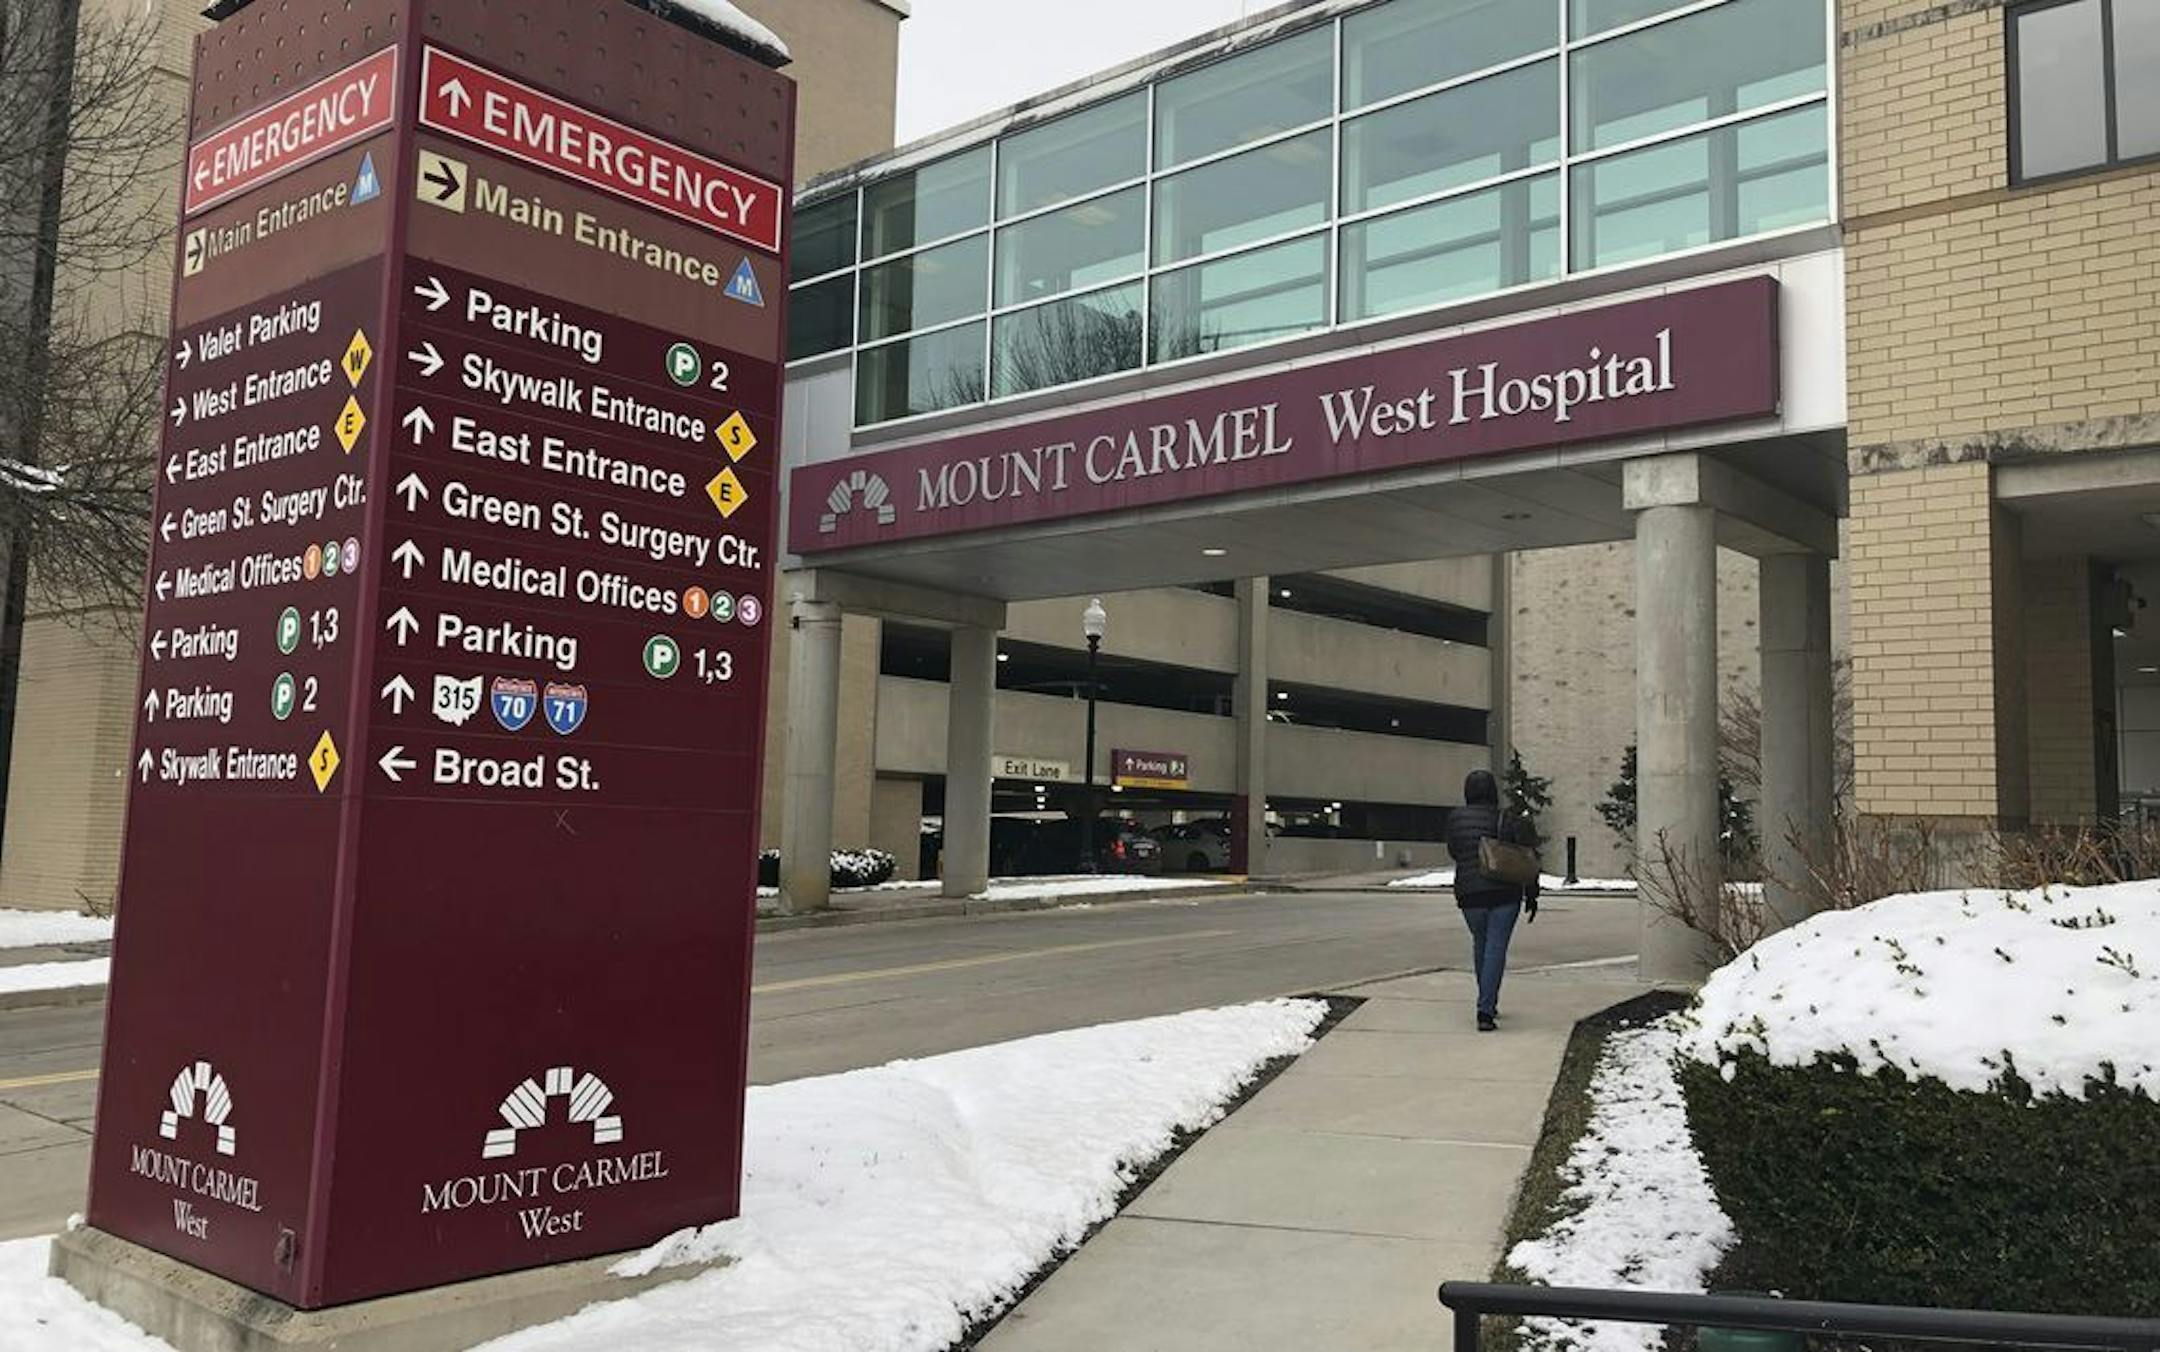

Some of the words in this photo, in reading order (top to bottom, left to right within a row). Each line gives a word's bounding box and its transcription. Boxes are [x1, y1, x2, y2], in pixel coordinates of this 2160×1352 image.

[212, 73, 378, 187] EMERGENCY
[483, 90, 757, 228] EMERGENCY
[207, 221, 251, 260] Main
[256, 182, 348, 240] Entrance
[359, 172, 373, 193] M
[475, 178, 564, 236] Main
[574, 211, 720, 287] Entrance
[737, 275, 752, 296] M
[198, 322, 243, 362] Valet
[248, 300, 322, 347] Parking
[466, 288, 604, 365] Parking
[675, 352, 693, 377] P
[710, 361, 731, 392] 2
[192, 381, 238, 421] West
[243, 358, 333, 407] Entrance
[349, 348, 365, 372] W
[462, 352, 584, 415] Skywalk
[591, 386, 706, 443] Entrance
[730, 424, 743, 446] S
[185, 443, 227, 480] East
[233, 424, 321, 469] Entrance
[344, 412, 354, 435] E
[916, 441, 1076, 512] MOUNT
[1084, 402, 1293, 484] CARMEL
[1318, 385, 1437, 445] West
[1447, 327, 1676, 424] Hospital
[451, 416, 532, 466] East
[542, 436, 686, 498] Entrance
[720, 481, 733, 503] E
[181, 507, 227, 540] Green
[232, 496, 254, 530] St.
[260, 486, 329, 526] Surgery
[333, 473, 367, 509] Ctr.
[442, 480, 541, 531] Green
[550, 501, 590, 540] St.
[600, 510, 712, 568] Surgery
[717, 534, 762, 569] Ctr.
[174, 560, 236, 599] Medical
[240, 552, 302, 590] Offices
[441, 547, 567, 599] Medical
[576, 568, 678, 615] Offices
[170, 623, 240, 661] Parking
[282, 616, 297, 645] P
[309, 607, 340, 650] 1,3
[436, 612, 578, 672] Parking
[651, 643, 671, 670] P
[693, 647, 734, 685] 1,3
[165, 685, 234, 724] Parking
[277, 682, 291, 710] P
[302, 675, 319, 712] 2
[438, 684, 475, 711] 315
[500, 695, 526, 719] 70
[553, 700, 576, 723] 71
[159, 748, 222, 787] Skywalk
[226, 746, 298, 780] Entrance
[433, 747, 545, 789] Broad
[555, 756, 600, 791] St.
[1004, 760, 1028, 777] Exit
[1032, 762, 1062, 780] Lane
[1135, 758, 1168, 776] Parking
[130, 1144, 192, 1189] MOUNT
[191, 1163, 263, 1213] CARMEL
[421, 1168, 545, 1214] MOUNT
[551, 1150, 669, 1196] CARMEL
[173, 1198, 209, 1240] West
[518, 1208, 584, 1241] West
